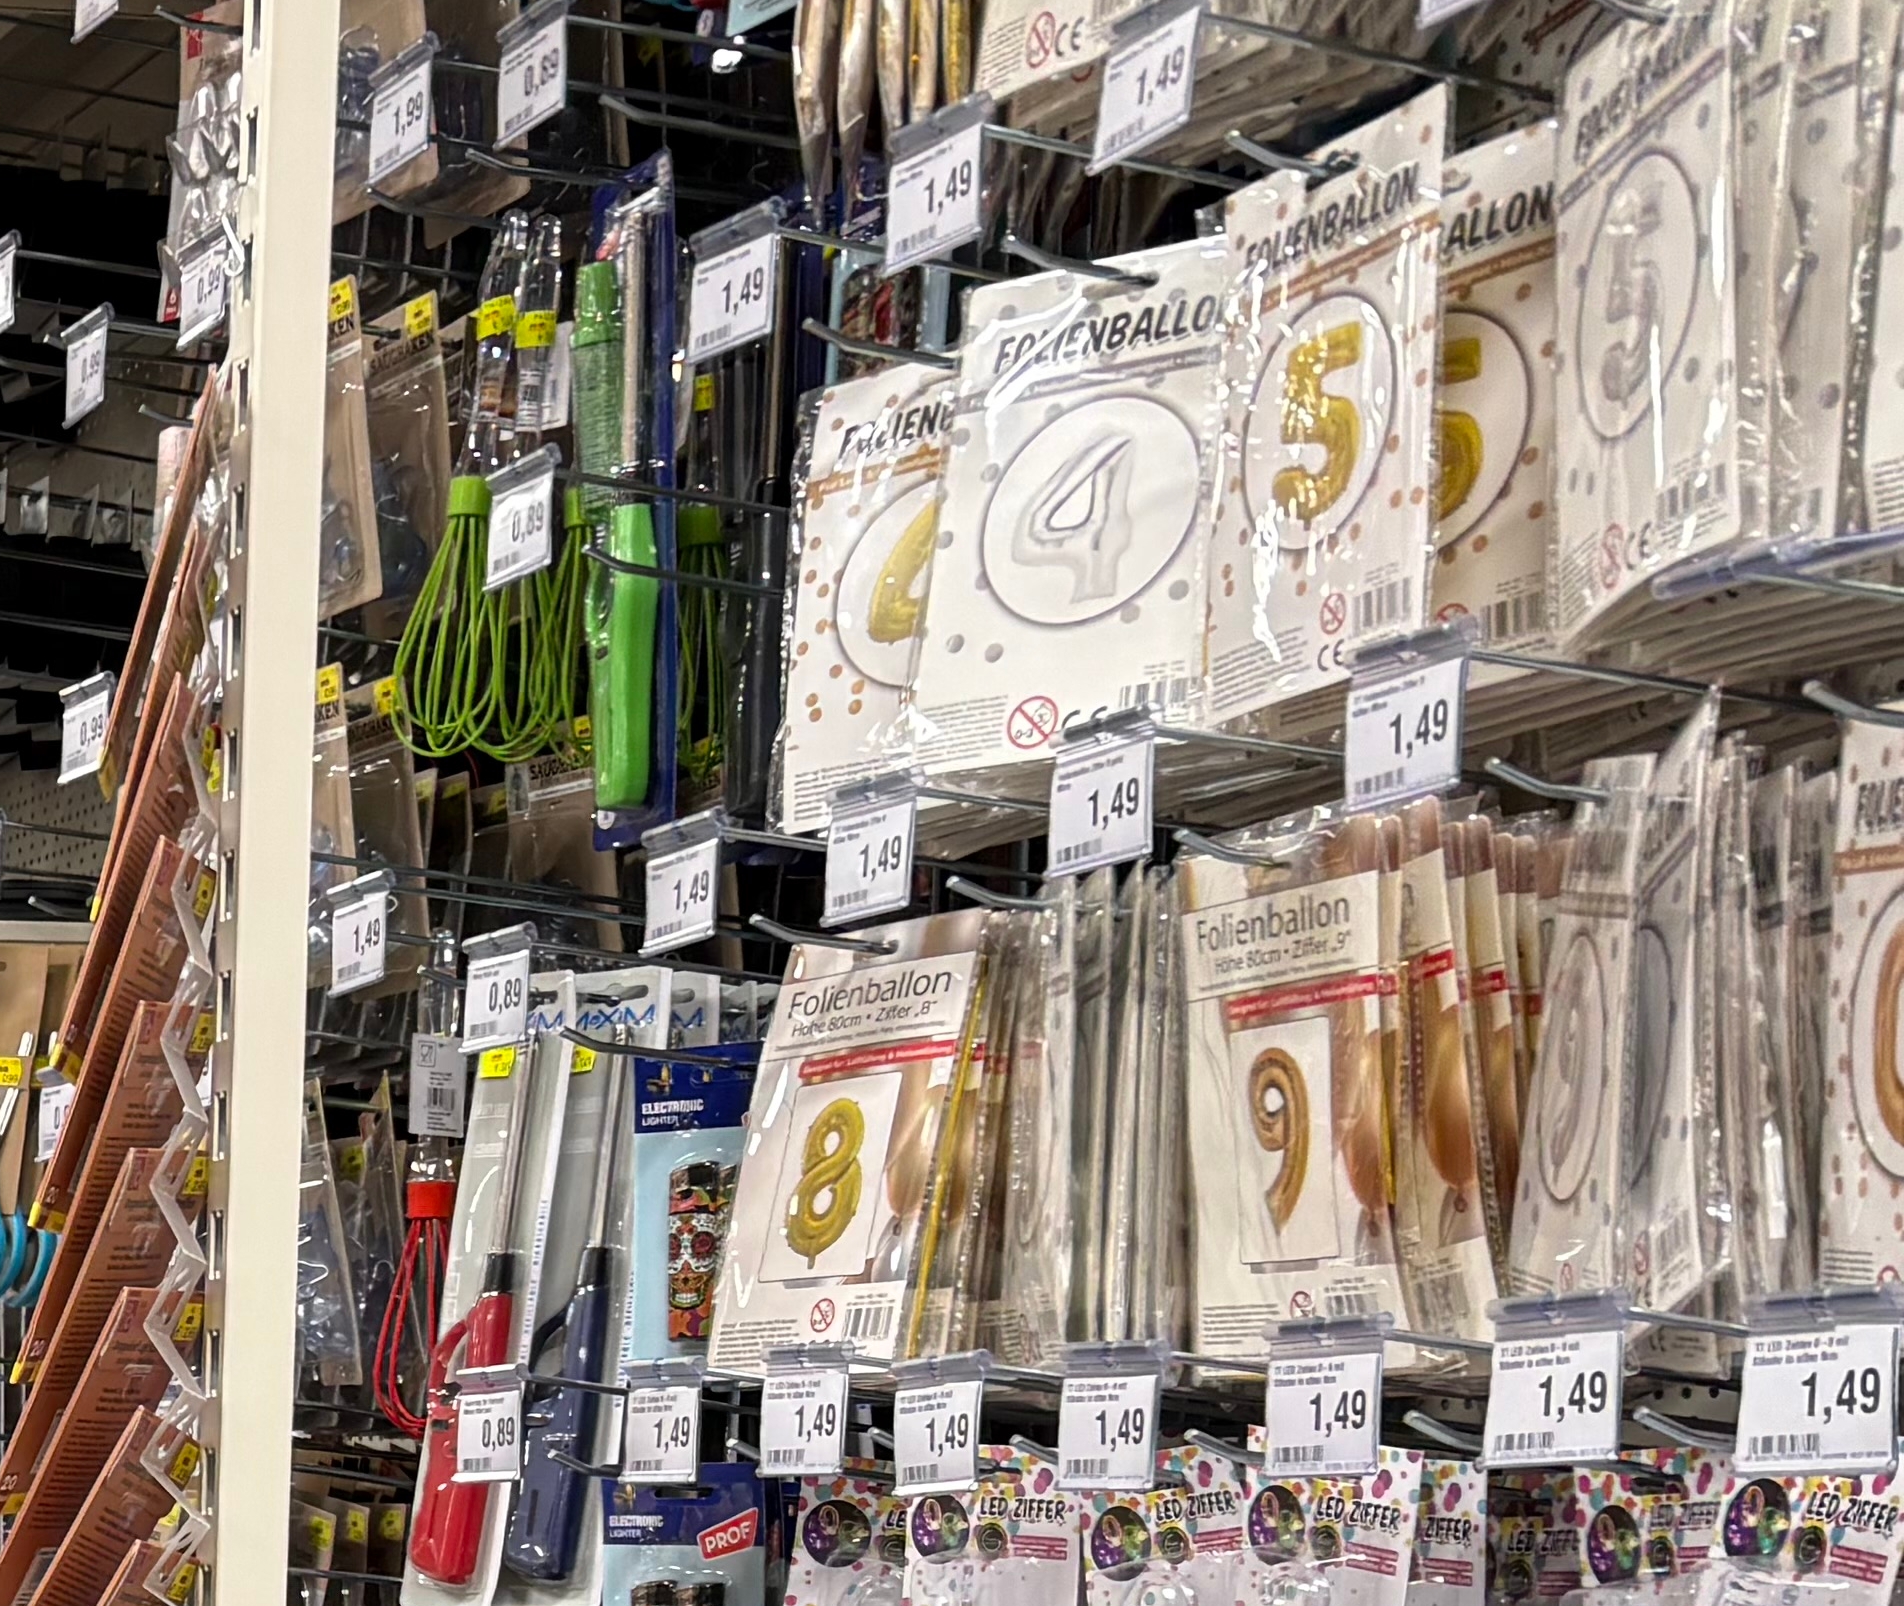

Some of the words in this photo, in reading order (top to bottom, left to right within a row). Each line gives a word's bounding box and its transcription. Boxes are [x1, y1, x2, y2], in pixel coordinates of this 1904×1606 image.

[1136, 45, 1185, 105] 1,49
[924, 159, 973, 216] 1,49
[722, 266, 764, 316] 1,49
[993, 294, 1225, 376] FOLIENBALLO
[1389, 699, 1450, 761] 1,49
[1088, 778, 1140, 831] 1,49
[859, 835, 902, 882] 1,49
[673, 869, 709, 913] 1,49
[353, 917, 382, 952] 1,49
[1196, 893, 1351, 954] Folienballon
[488, 978, 523, 1017] 0,89
[788, 970, 952, 1020] Folienballon
[1309, 1389, 1367, 1432] 1,49
[1538, 1370, 1608, 1423] 1,49
[1801, 1367, 1881, 1425] 1,49
[481, 1416, 516, 1450] 0,89
[653, 1416, 691, 1455] 1,49
[794, 1403, 837, 1443] 1,49
[925, 1416, 969, 1454] 1,49
[1096, 1408, 1145, 1448] 1,49
[979, 1496, 1009, 1520] LED
[1013, 1497, 1068, 1522] ZIFFER
[1806, 1490, 1841, 1519] LED
[704, 1521, 752, 1553] PROF
